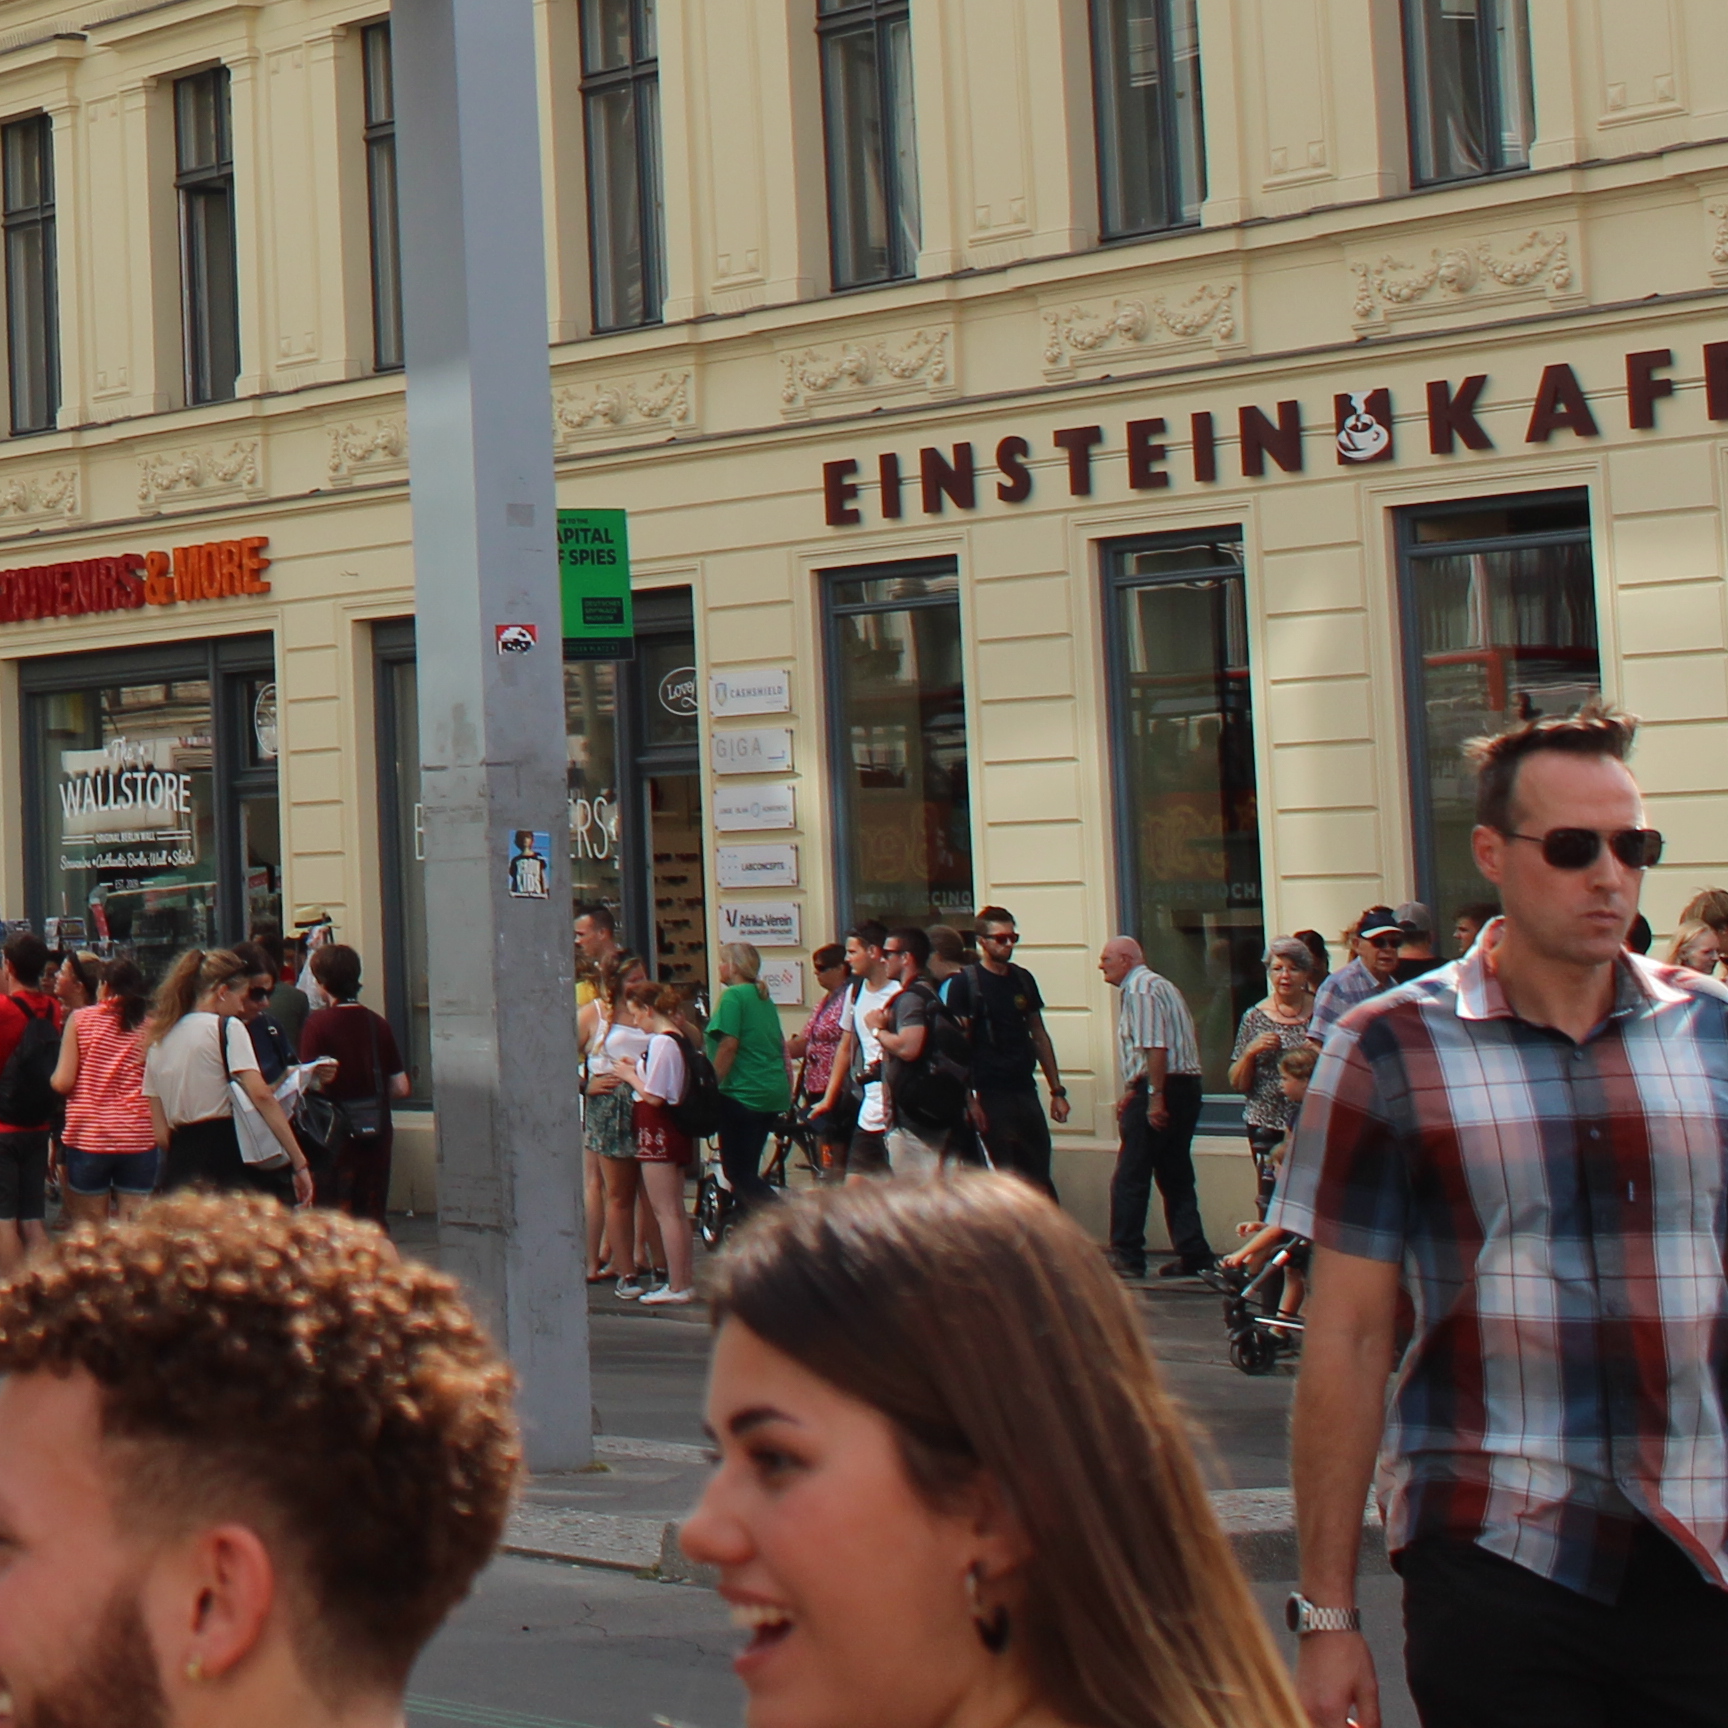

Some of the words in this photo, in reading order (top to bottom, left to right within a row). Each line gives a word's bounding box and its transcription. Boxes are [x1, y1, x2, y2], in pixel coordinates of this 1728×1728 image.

[824, 399, 1303, 527] EINSTEIN
[557, 527, 614, 544] PITAL
[569, 549, 617, 565] SPIES
[173, 536, 271, 602] MORE
[729, 686, 783, 699] CASHSHIELD
[59, 771, 192, 819] WALLSTORE
[741, 862, 785, 871] LABCONCEPTS
[739, 914, 792, 927] Afrika-Verein
